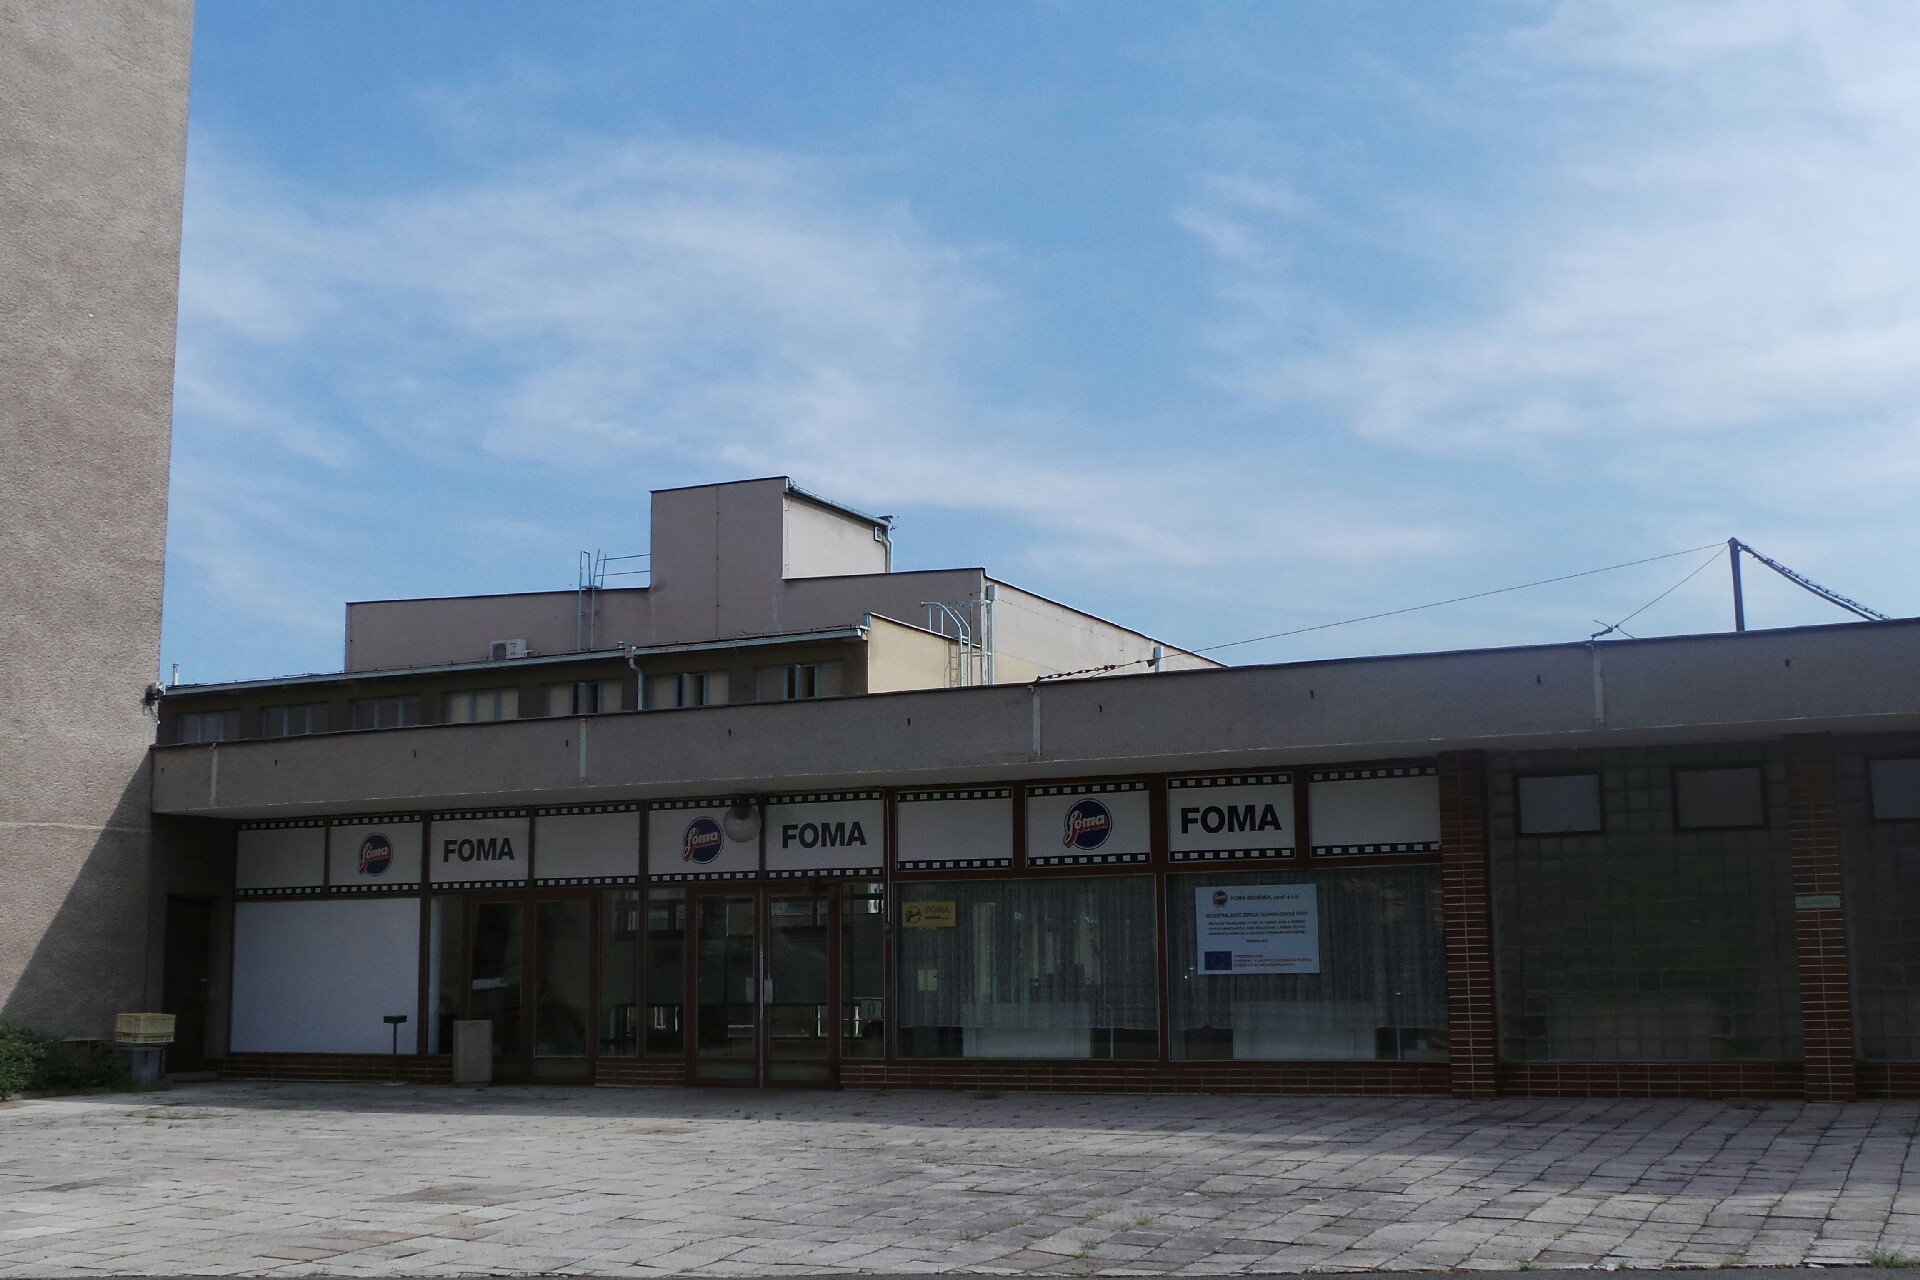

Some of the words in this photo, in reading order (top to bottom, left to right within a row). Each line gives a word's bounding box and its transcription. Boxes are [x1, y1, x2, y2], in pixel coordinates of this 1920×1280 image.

[1063, 810, 1108, 848] foma
[1181, 804, 1282, 834] FOMA
[443, 838, 514, 862] FOMA
[682, 827, 721, 862] foma
[782, 821, 867, 849] FOMA
[358, 842, 392, 875] foma
